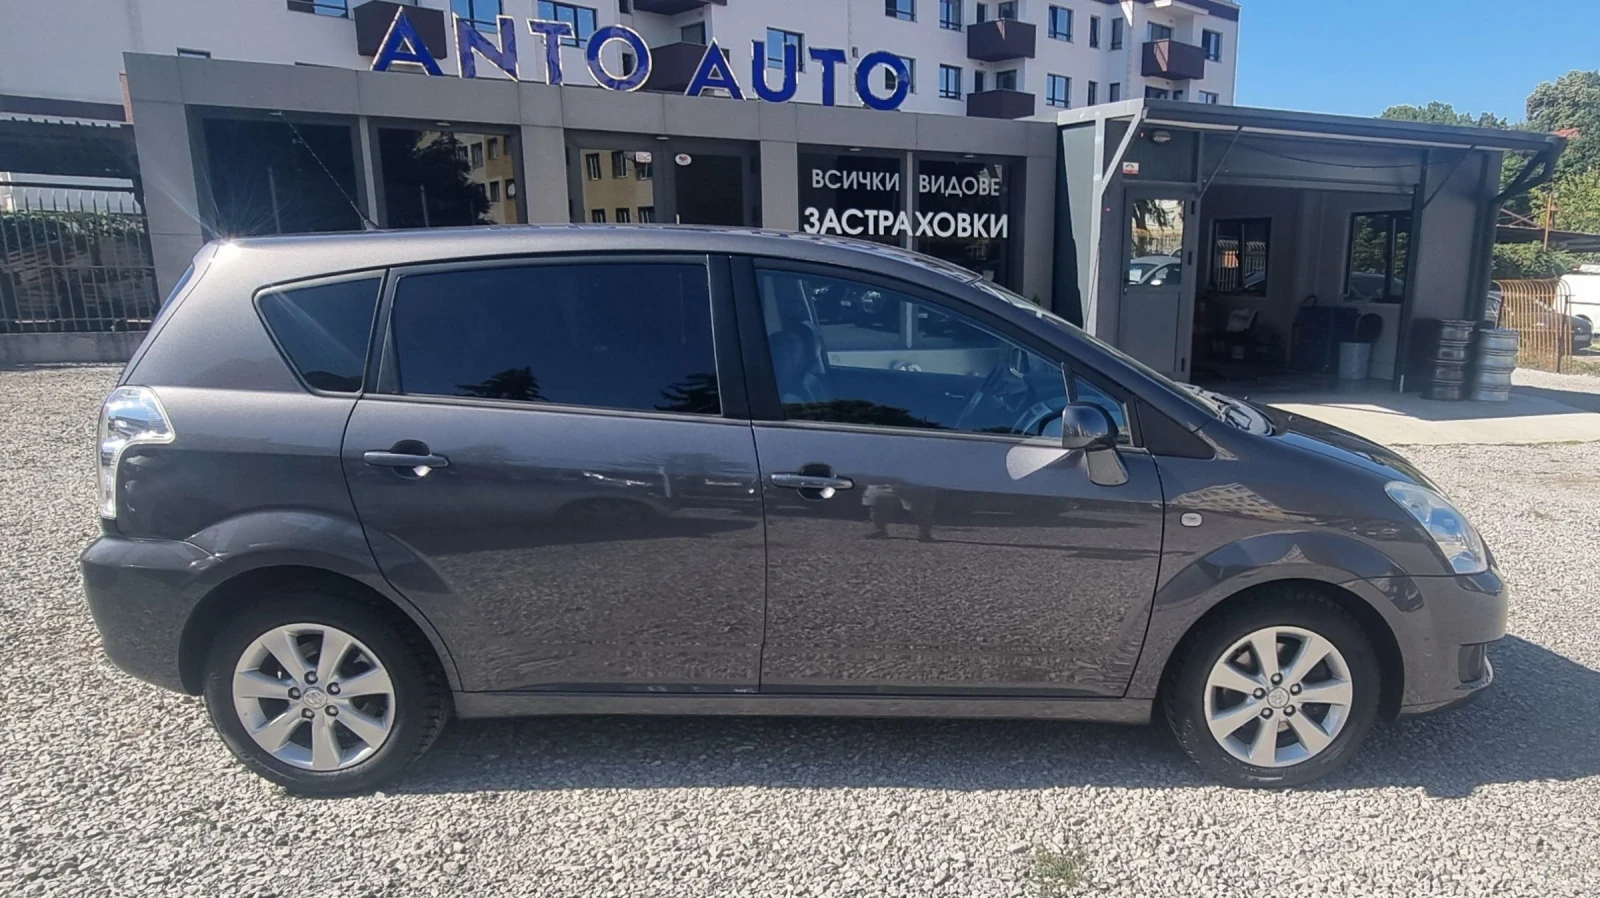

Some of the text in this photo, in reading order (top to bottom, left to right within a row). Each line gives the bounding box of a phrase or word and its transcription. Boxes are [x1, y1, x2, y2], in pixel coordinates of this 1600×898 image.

[369, 5, 911, 111] ANTO AUTO
[811, 168, 1000, 197] ВСИЧКИ ВИДОВЕ
[803, 207, 1008, 239] ЗАСТРАХОВКИ
